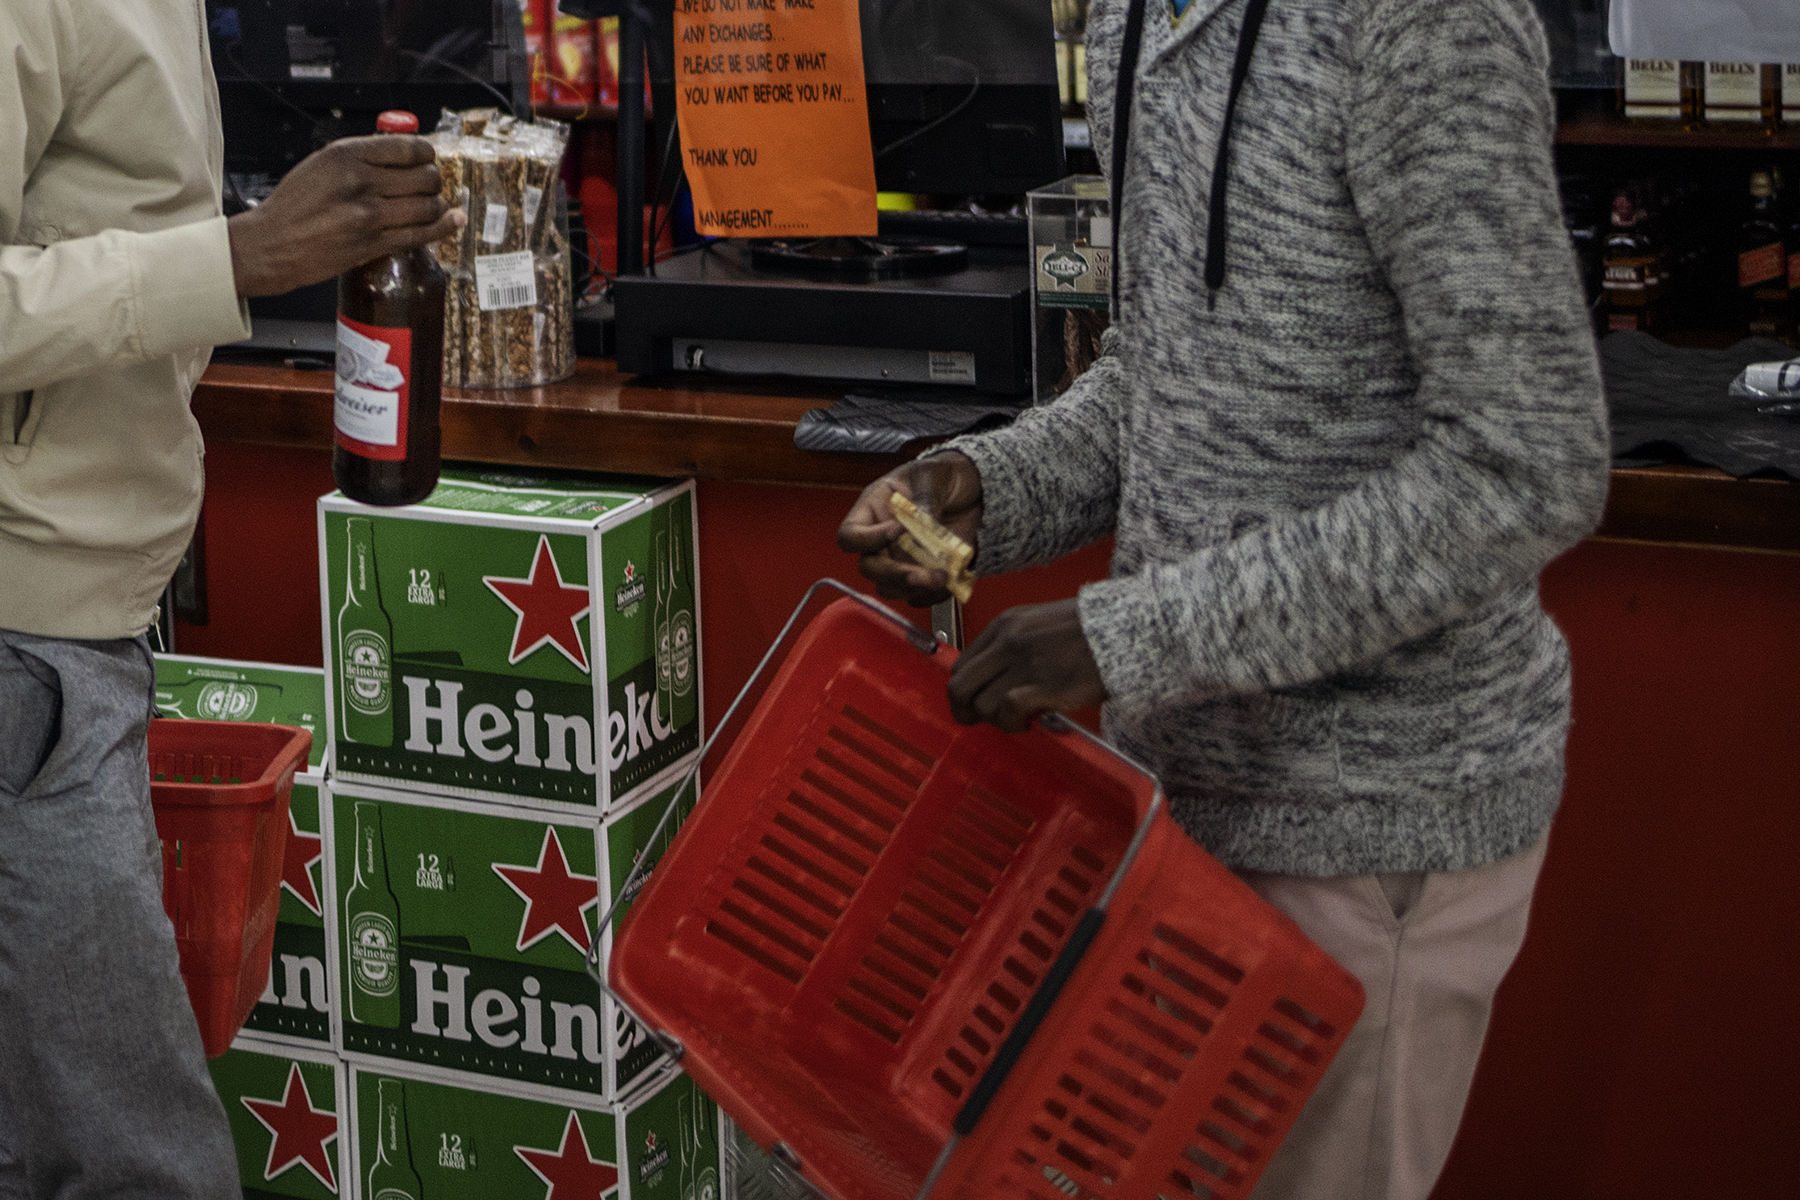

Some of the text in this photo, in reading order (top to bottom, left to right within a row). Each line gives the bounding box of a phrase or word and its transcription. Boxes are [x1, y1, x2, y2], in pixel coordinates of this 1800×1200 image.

[683, 25, 705, 43] ANY
[683, 52, 827, 74] PLEASE BE SURE OF WHAT
[685, 86, 709, 105] YOU
[714, 85, 749, 104] WANT
[753, 84, 794, 103] BEFORE
[796, 84, 819, 101] YOU
[689, 148, 757, 167] THANK YOU
[335, 384, 388, 415] dweiser
[409, 568, 431, 588] 12
[408, 586, 435, 599] EXTRA
[408, 594, 435, 606] LARGE
[346, 662, 389, 679] Heineken
[418, 852, 440, 873] 12
[416, 870, 443, 883] EXTRA
[416, 878, 444, 891] LARGE
[353, 945, 396, 962] Heineken
[440, 1132, 461, 1152] 12
[439, 1147, 465, 1162] EXTRA
[439, 1157, 465, 1171] LARGE
